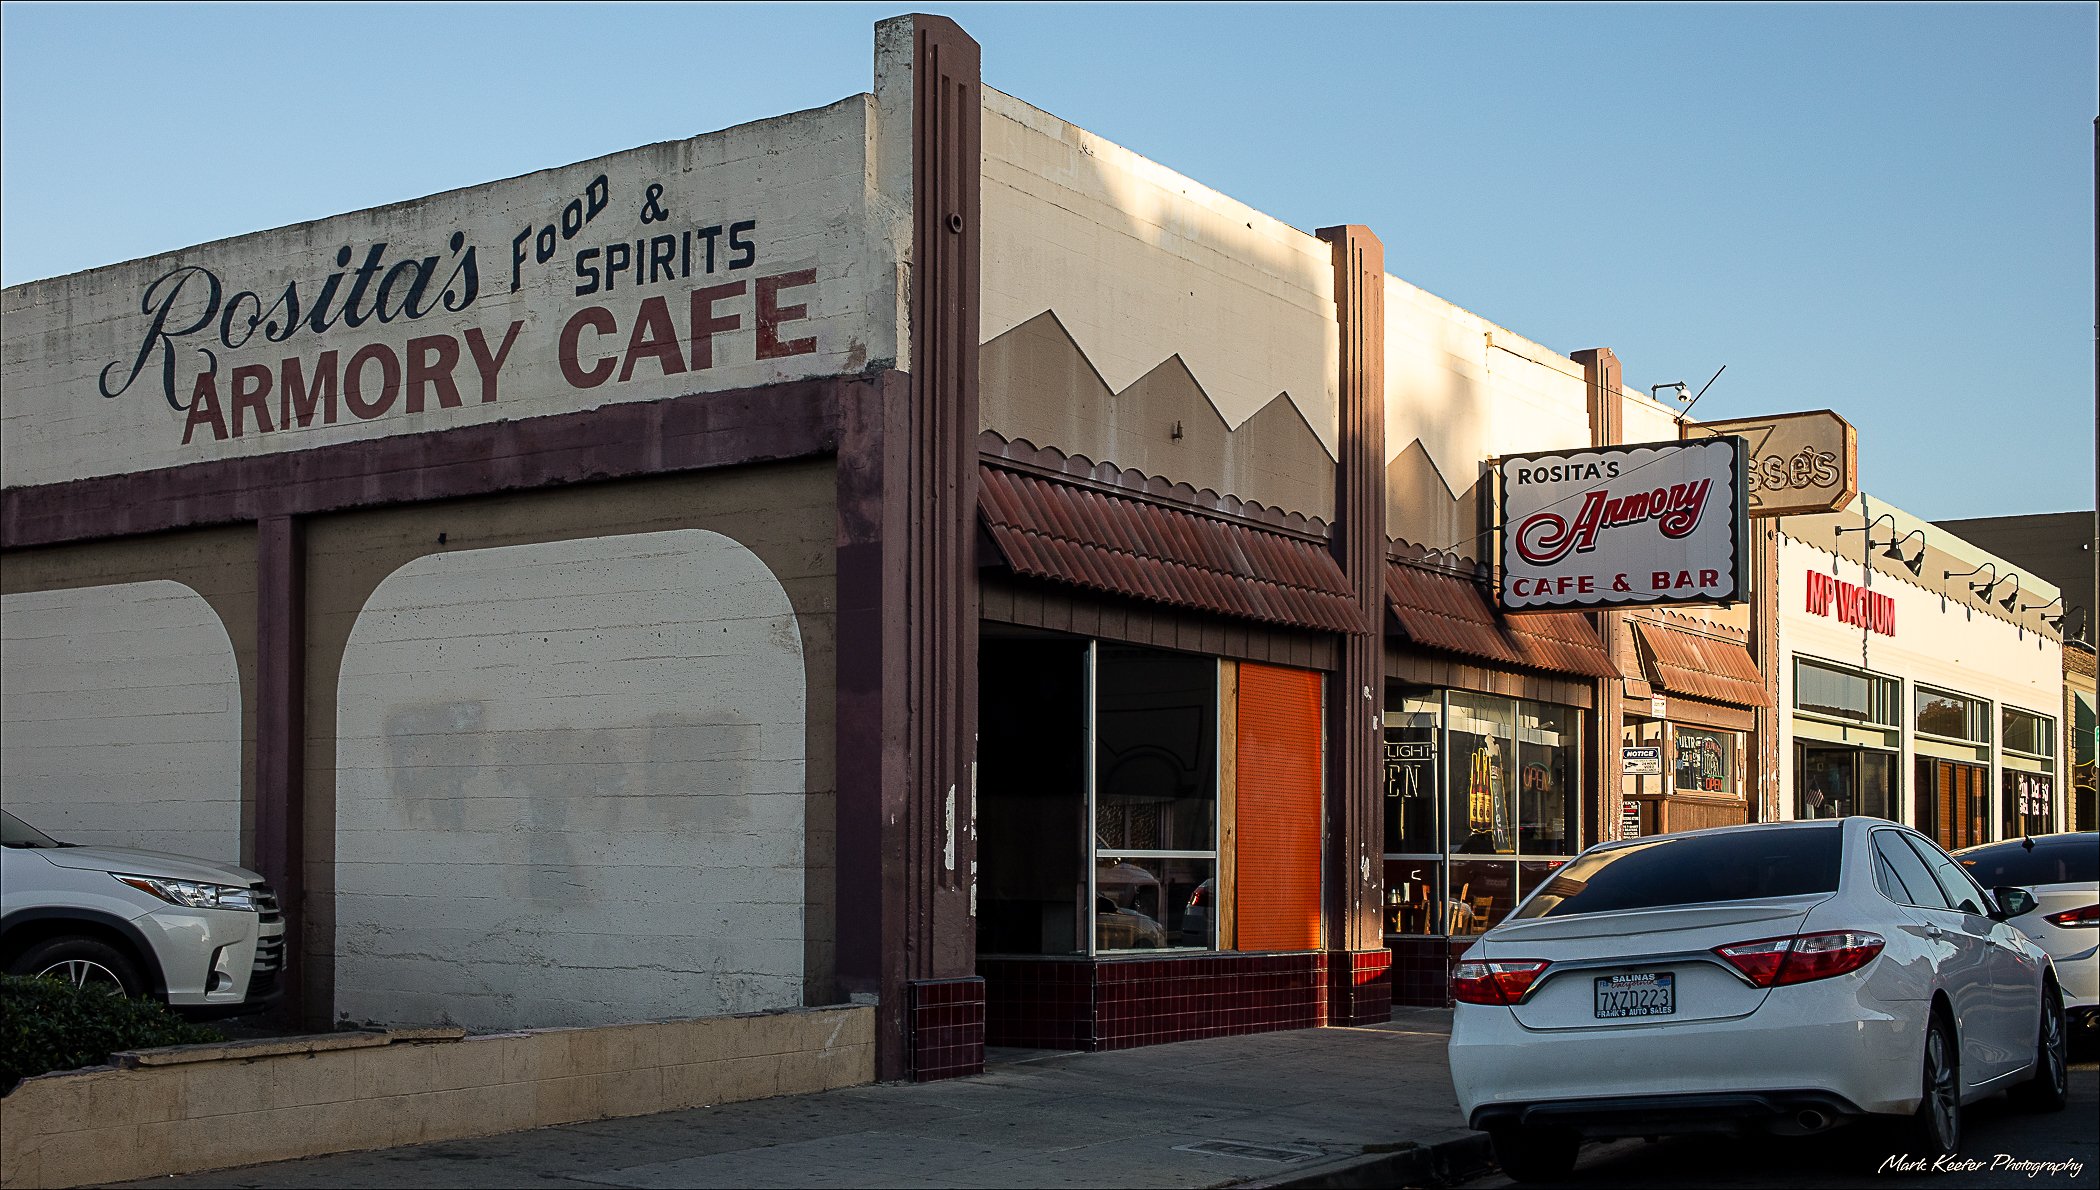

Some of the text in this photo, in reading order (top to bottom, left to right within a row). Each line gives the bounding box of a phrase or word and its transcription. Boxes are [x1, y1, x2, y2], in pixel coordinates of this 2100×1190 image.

[575, 220, 757, 298] SPIRITS
[98, 174, 669, 412] Rosita's FOOD &
[181, 267, 818, 446] ARMORY CAFE
[1518, 461, 1620, 485] ROSITA'S
[1515, 477, 1714, 567] Armory
[1512, 569, 1720, 598] CAFE & BAR
[1805, 569, 1896, 638] MP VACUUM
[1523, 766, 1551, 791] OPEN
[1705, 777, 1722, 790] OPEN
[1612, 973, 1655, 983] SALINAS
[1597, 1006, 1672, 1018] FRANK'S AUTO SALES
[1600, 988, 1669, 1012] 7XZD223
